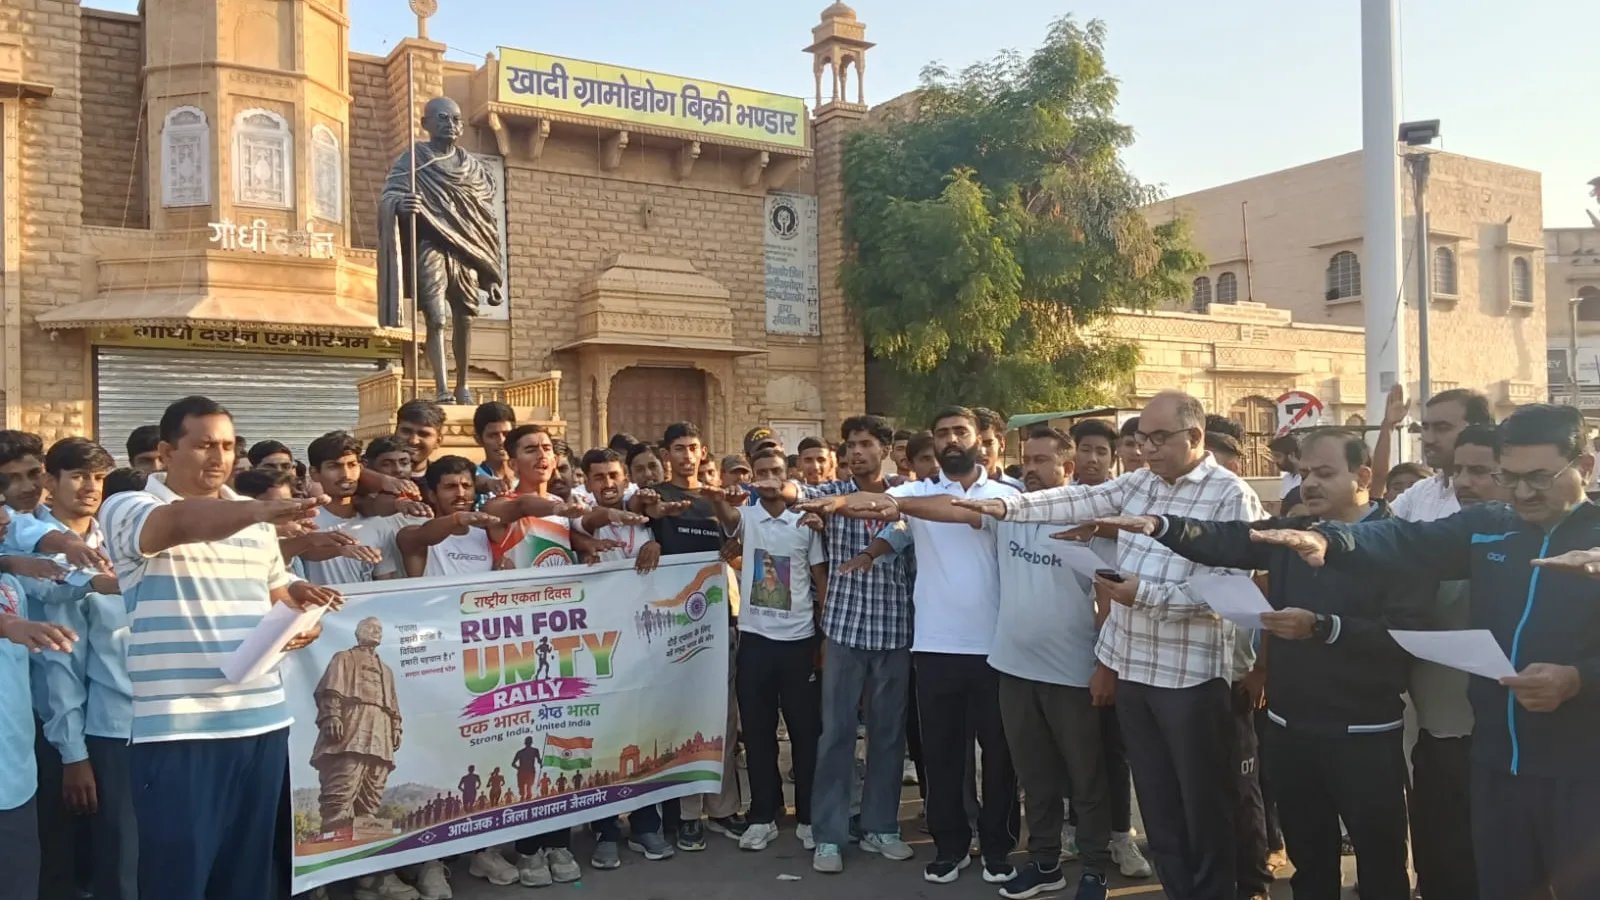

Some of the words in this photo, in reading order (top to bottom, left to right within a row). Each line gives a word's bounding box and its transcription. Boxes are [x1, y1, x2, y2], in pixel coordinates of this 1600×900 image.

[506, 63, 569, 100] खादी
[573, 74, 677, 117] ग्रामोद्योग
[681, 84, 732, 126] बिक्री
[736, 104, 798, 136] भण्डार
[474, 591, 508, 610] राष्ट्रीय
[511, 590, 541, 606] एकता
[544, 586, 572, 602] दिवस
[460, 614, 525, 645] RUN
[531, 607, 588, 635] FOR
[462, 630, 622, 695] UNITY
[492, 679, 564, 710] RALLY
[458, 718, 489, 739] एक
[493, 710, 535, 730] भारत,
[537, 703, 564, 721] श्रेष्ठ
[567, 702, 600, 718] भारत
[469, 732, 504, 748] Strong
[535, 720, 566, 733] United
[568, 718, 591, 729] India
[1241, 757, 1255, 775] 07
[447, 816, 493, 838] आयोजक
[502, 808, 529, 826] जिला
[531, 799, 567, 819] प्रशासन
[569, 788, 608, 809] जैसलमेर
